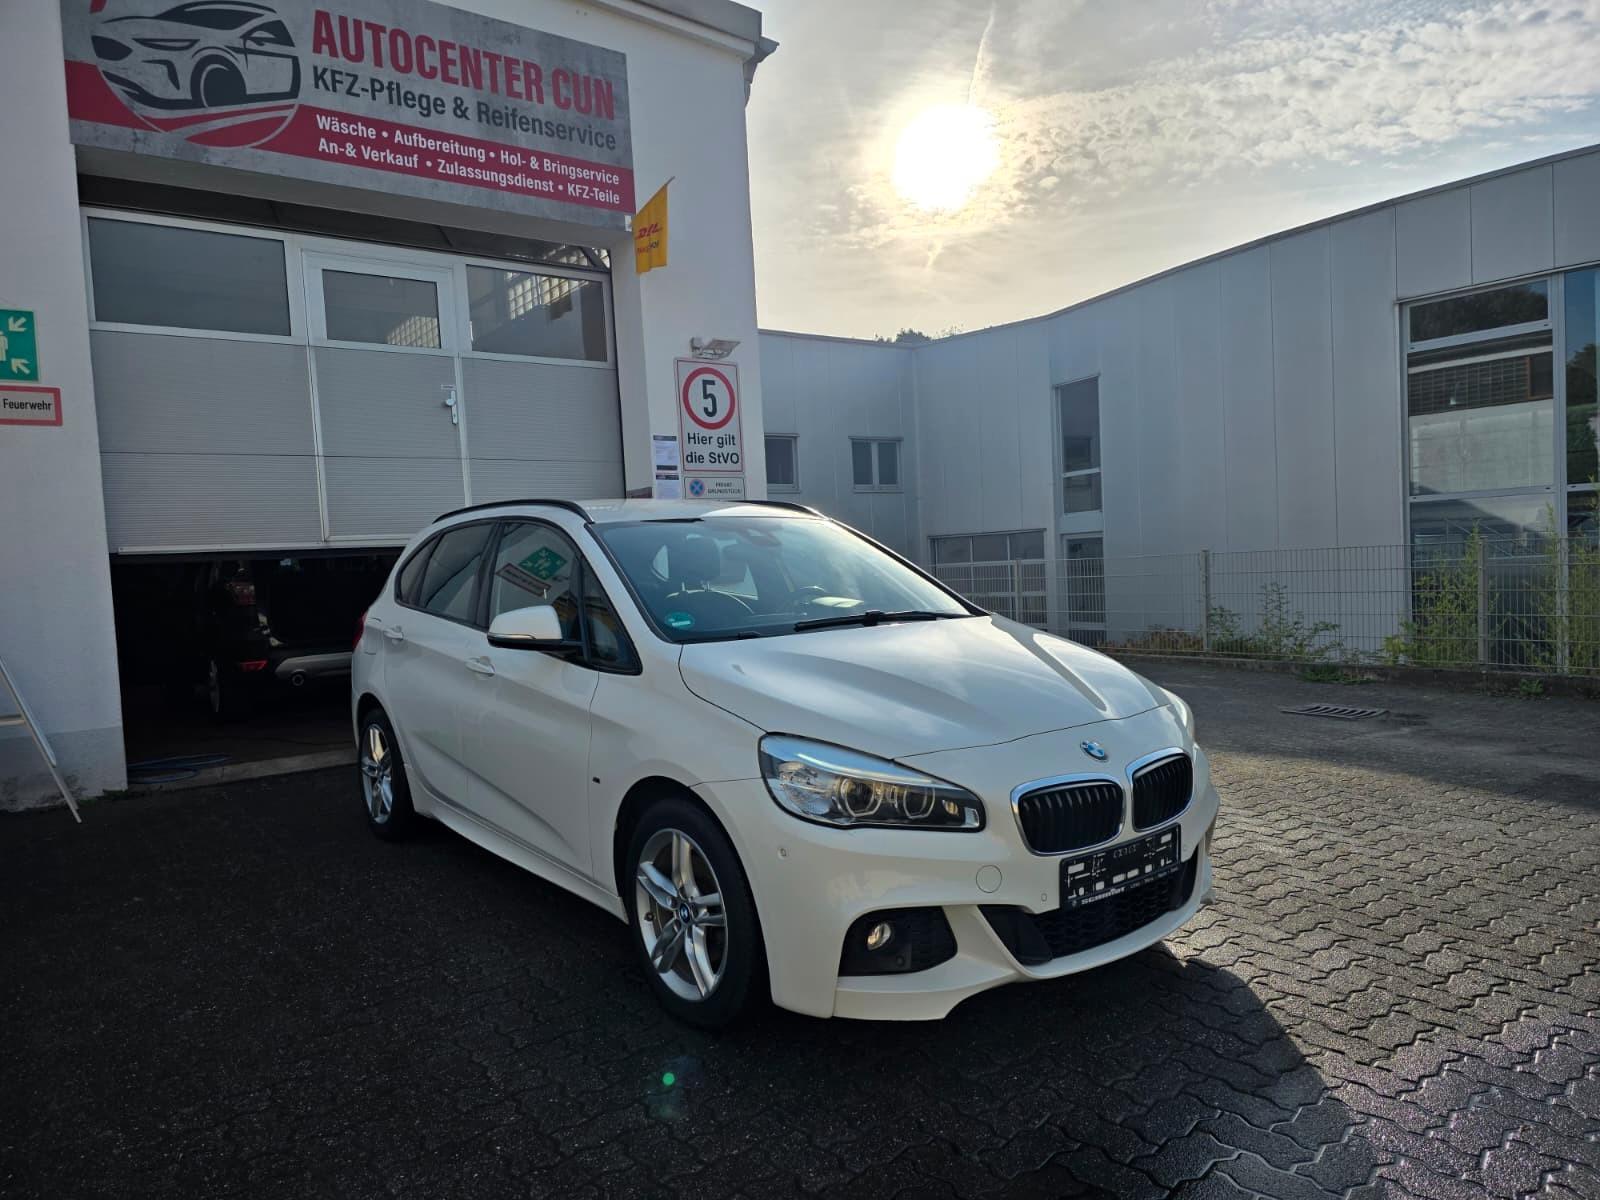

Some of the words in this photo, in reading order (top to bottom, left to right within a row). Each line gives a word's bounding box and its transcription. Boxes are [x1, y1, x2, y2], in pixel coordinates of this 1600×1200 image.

[312, 9, 545, 105] AUTOCENTER
[551, 66, 615, 121] CUN
[312, 65, 446, 118] KFZ-Pflege
[453, 96, 470, 121] &
[477, 100, 616, 151] Reifenservice
[316, 114, 377, 139] Wäsche
[394, 129, 486, 162] Aufbereitung
[500, 149, 526, 167] Hol-
[530, 156, 540, 171] &
[543, 158, 620, 185] Bringservice
[361, 144, 419, 169] Verkauf
[437, 158, 554, 193] Zulassungsdienst
[567, 182, 620, 205] KFZ-Teile
[3, 398, 52, 411] Feuerwehr
[701, 379, 718, 418] 5
[685, 451, 705, 464] die
[708, 451, 740, 465] StVO
[687, 432, 713, 446] Hier
[716, 433, 736, 449] gilt
